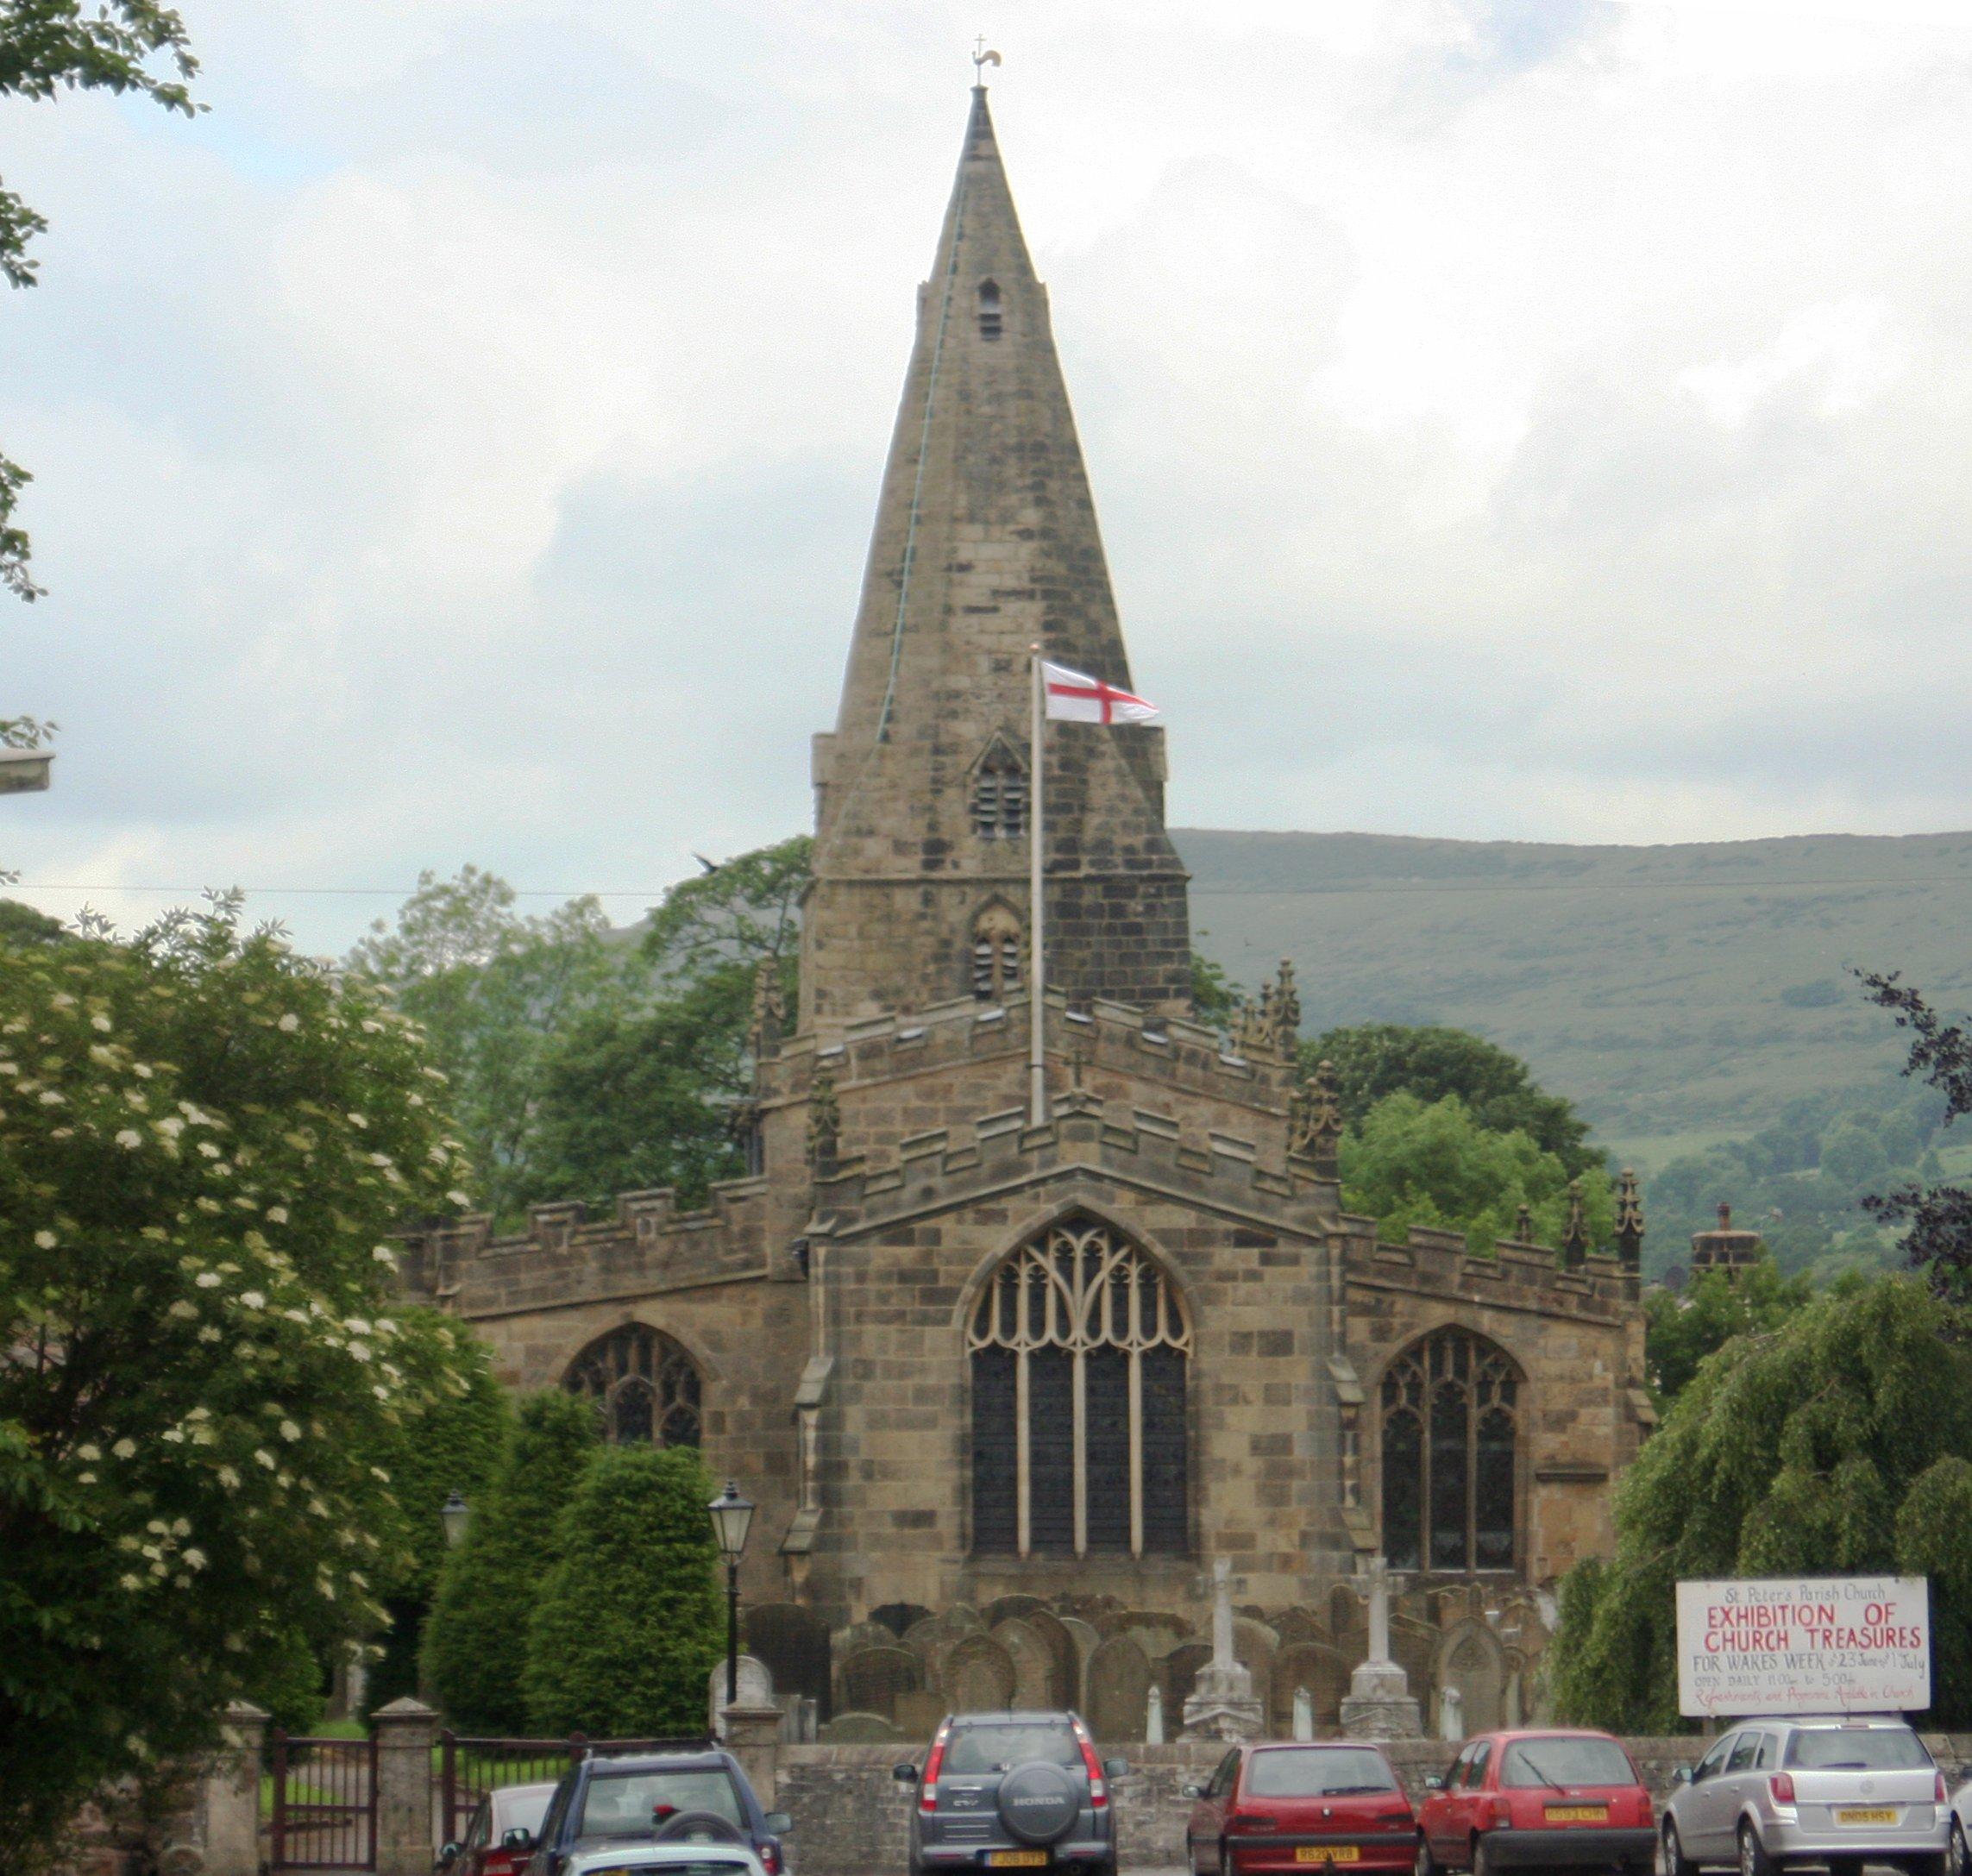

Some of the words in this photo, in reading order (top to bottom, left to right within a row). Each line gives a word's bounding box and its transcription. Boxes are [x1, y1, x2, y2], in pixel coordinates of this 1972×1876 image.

[1725, 1587, 1739, 1603] St
[1799, 1584, 1839, 1601] Parish
[1844, 1583, 1886, 1600] Church
[1707, 1604, 1835, 1628] EXHIBITION
[1864, 1603, 1897, 1626] OF
[1704, 1629, 1790, 1653] CHURCH
[1805, 1626, 1922, 1650] TREASURES
[1693, 1655, 1722, 1672] FOR
[1727, 1653, 1777, 1672] WAKES
[1784, 1653, 1825, 1671] WEEK
[1900, 1653, 1925, 1679] July
[1728, 1674, 1760, 1686] DAILY
[1013, 1797, 1065, 1807] HONDA
